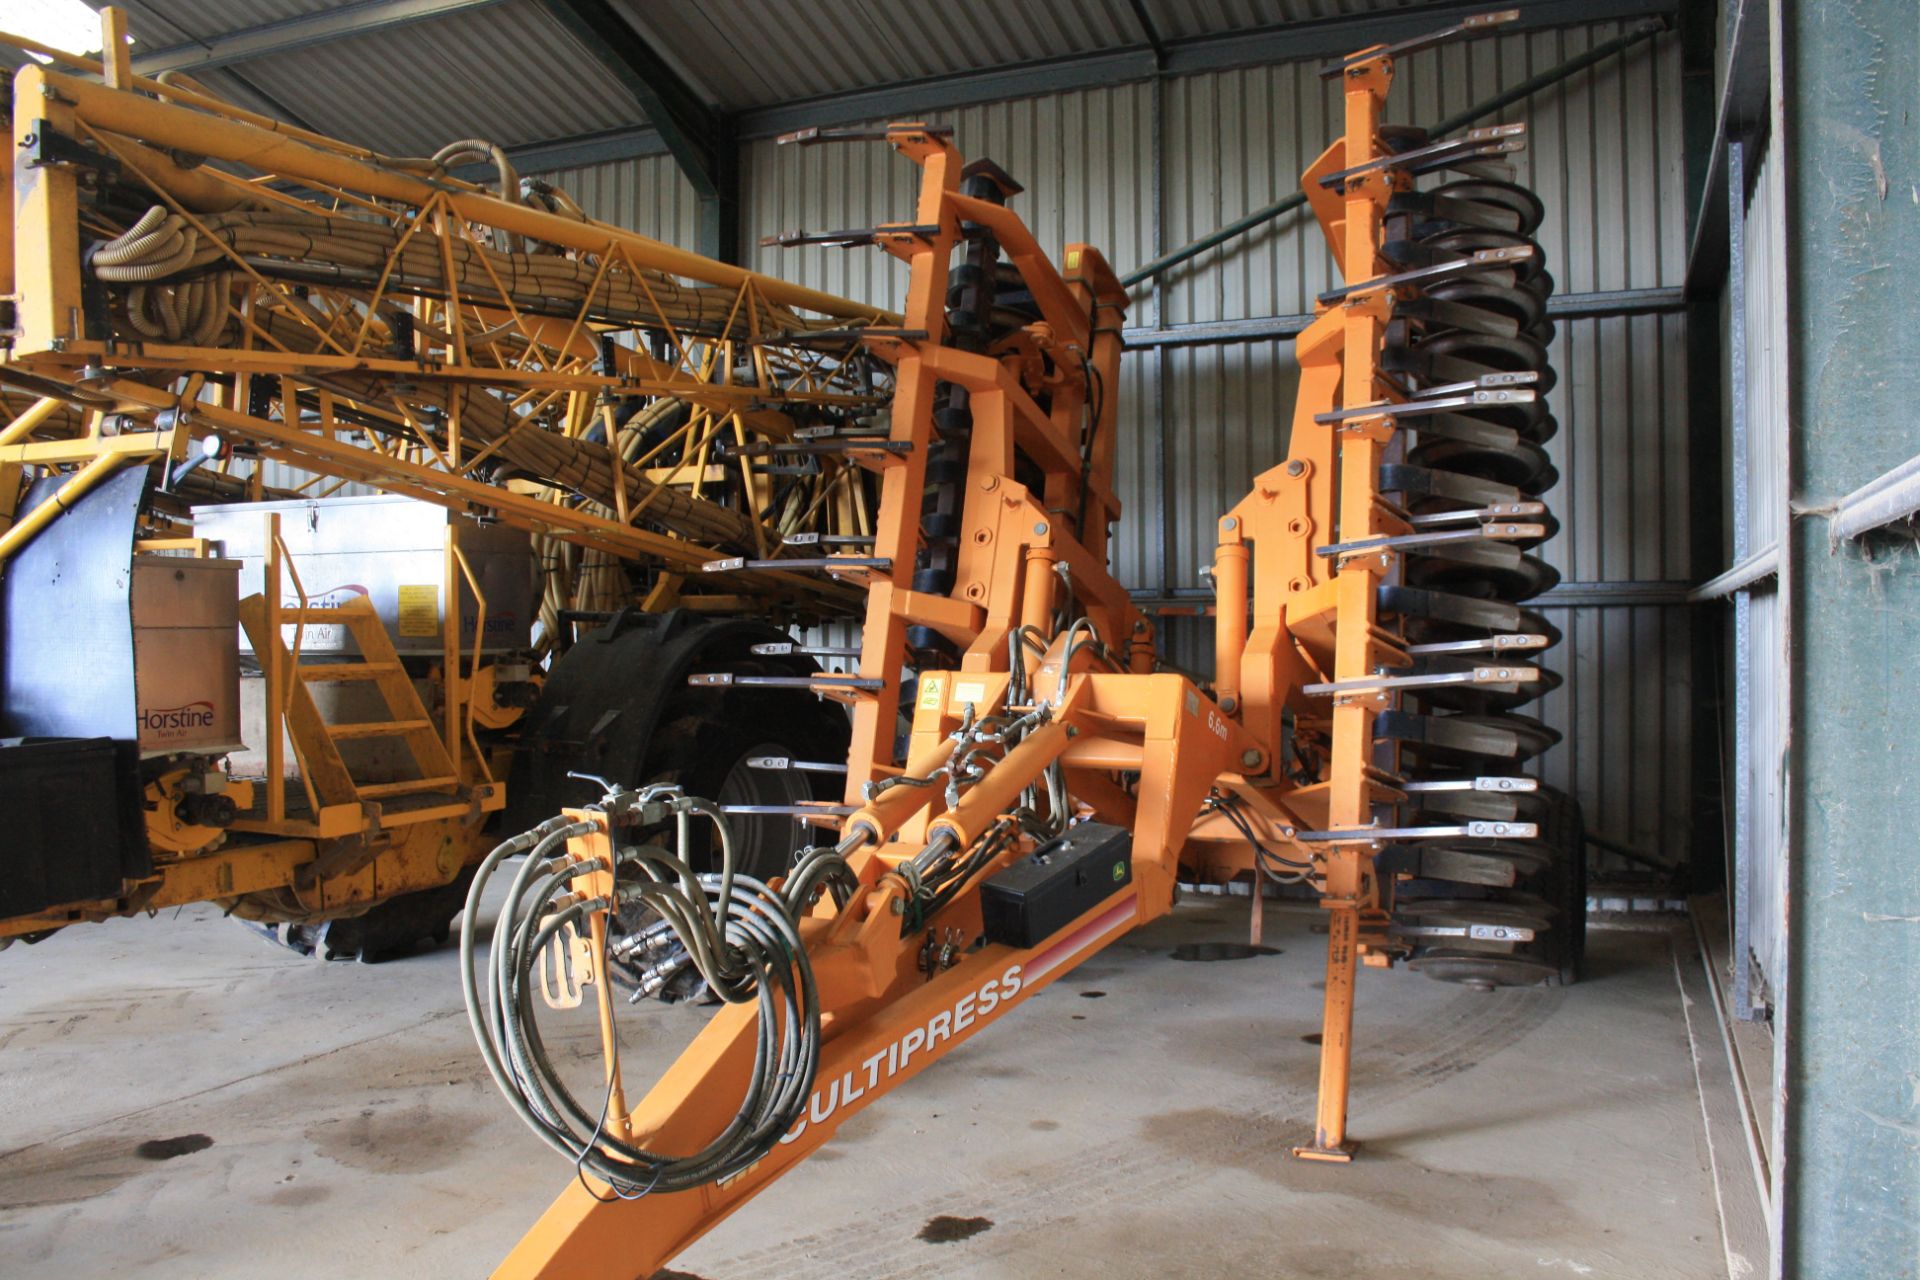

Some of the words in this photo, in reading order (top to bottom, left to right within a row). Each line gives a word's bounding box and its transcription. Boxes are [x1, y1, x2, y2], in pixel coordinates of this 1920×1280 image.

[317, 627, 332, 639] Air
[138, 708, 214, 729] Horstine
[1207, 710, 1228, 741] 6.6m
[158, 730, 174, 738] Twin
